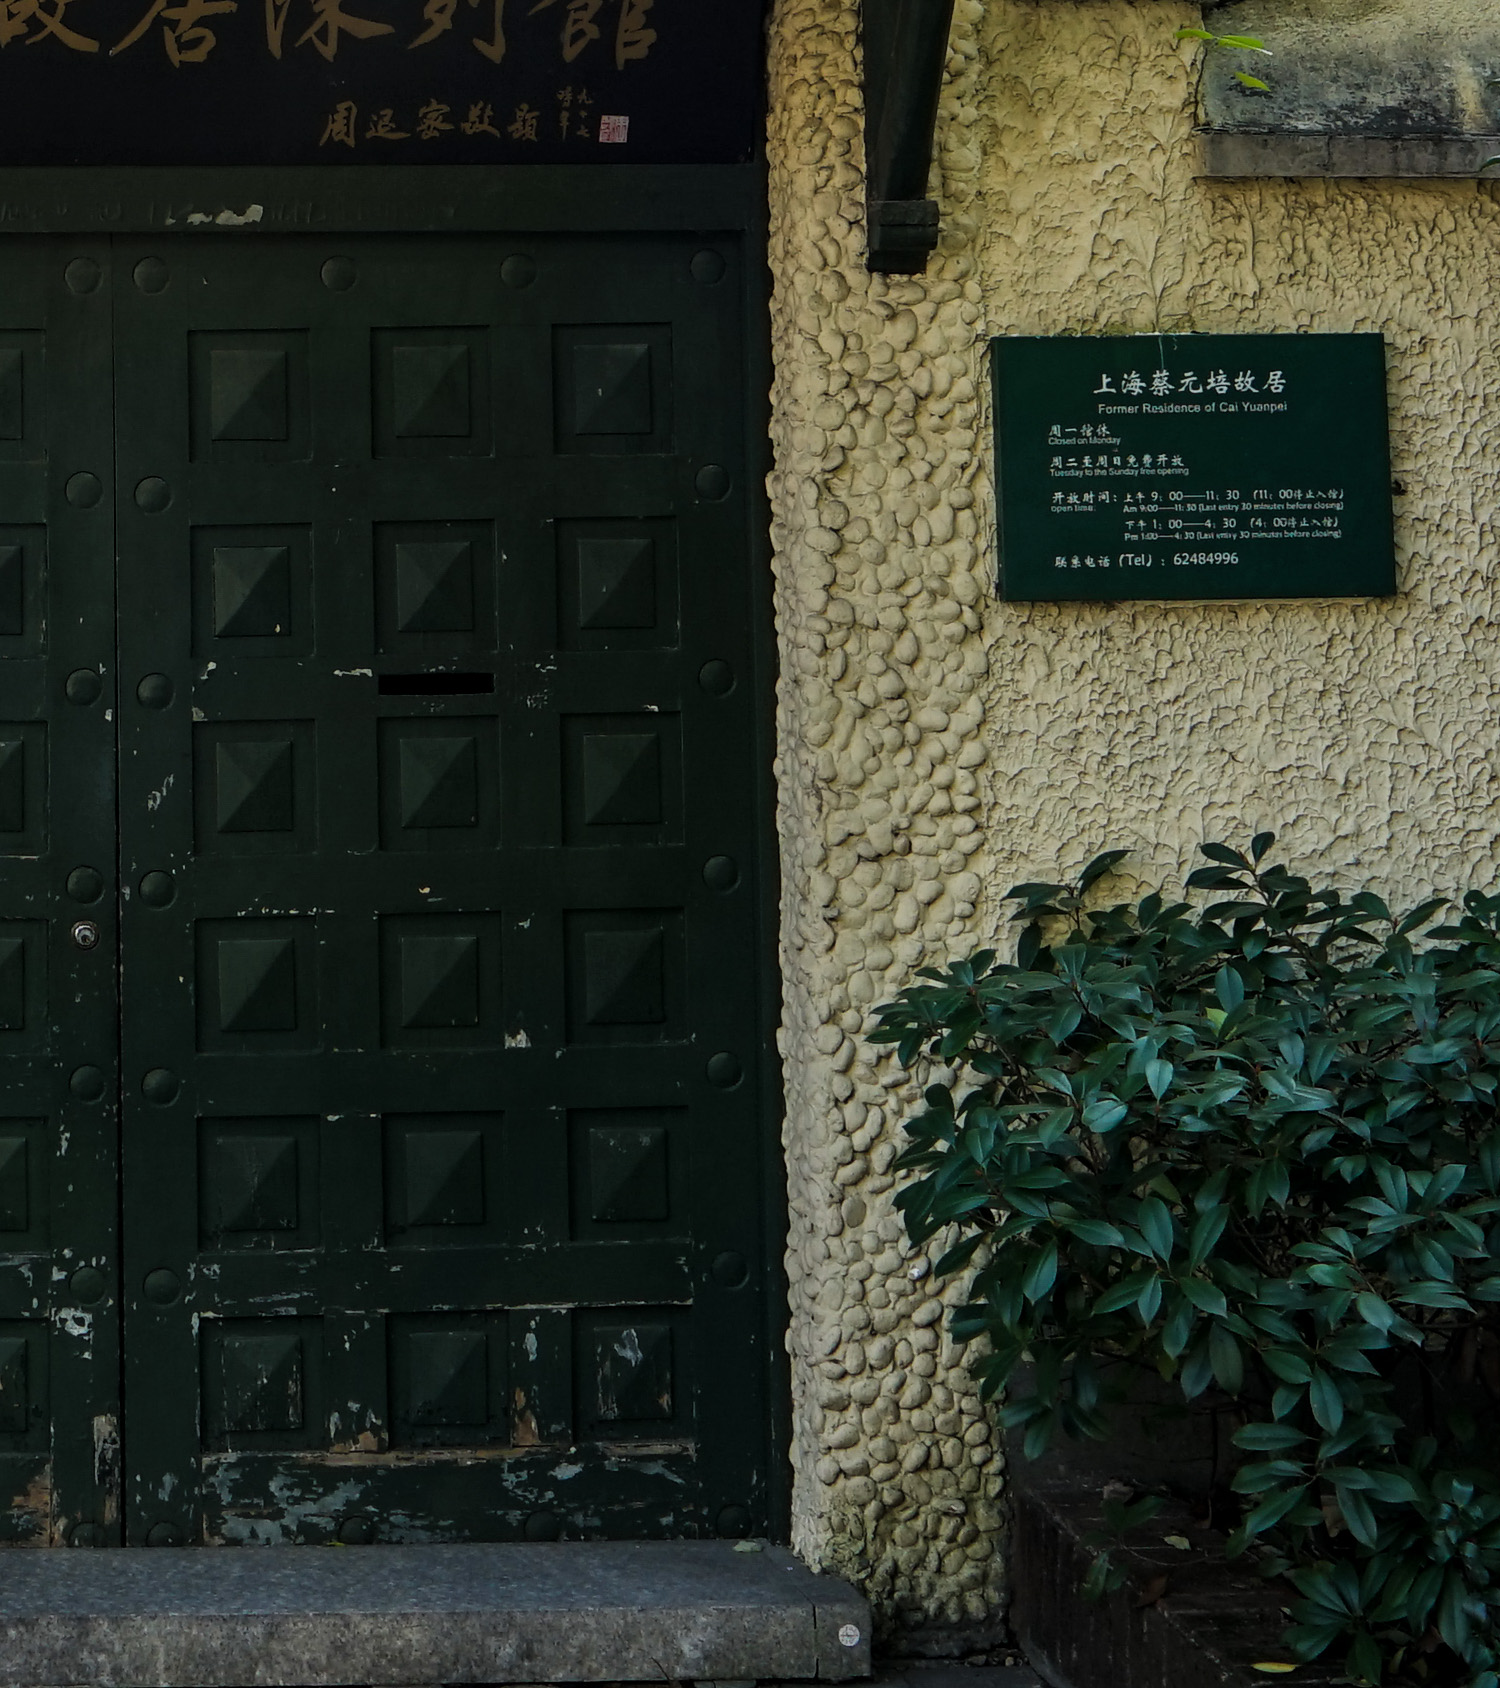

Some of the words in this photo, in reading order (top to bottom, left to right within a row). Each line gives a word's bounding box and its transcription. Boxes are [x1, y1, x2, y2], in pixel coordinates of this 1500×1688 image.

[1093, 368, 1287, 396] 上海蔡元培故居
[1098, 403, 1139, 414] Former
[1143, 402, 1201, 413] Residence
[1204, 402, 1216, 412] of
[1220, 401, 1239, 412] Cai
[1242, 401, 1288, 414] Yuanpei
[1048, 437, 1077, 445] Closed
[1077, 437, 1088, 445] on
[1089, 437, 1121, 446] Monday
[1050, 454, 1184, 468] 周二至周日免费开放
[1050, 469, 1083, 478] Tuesday
[1109, 468, 1138, 477] Sunday
[1173, 552, 1239, 566] 62484996
